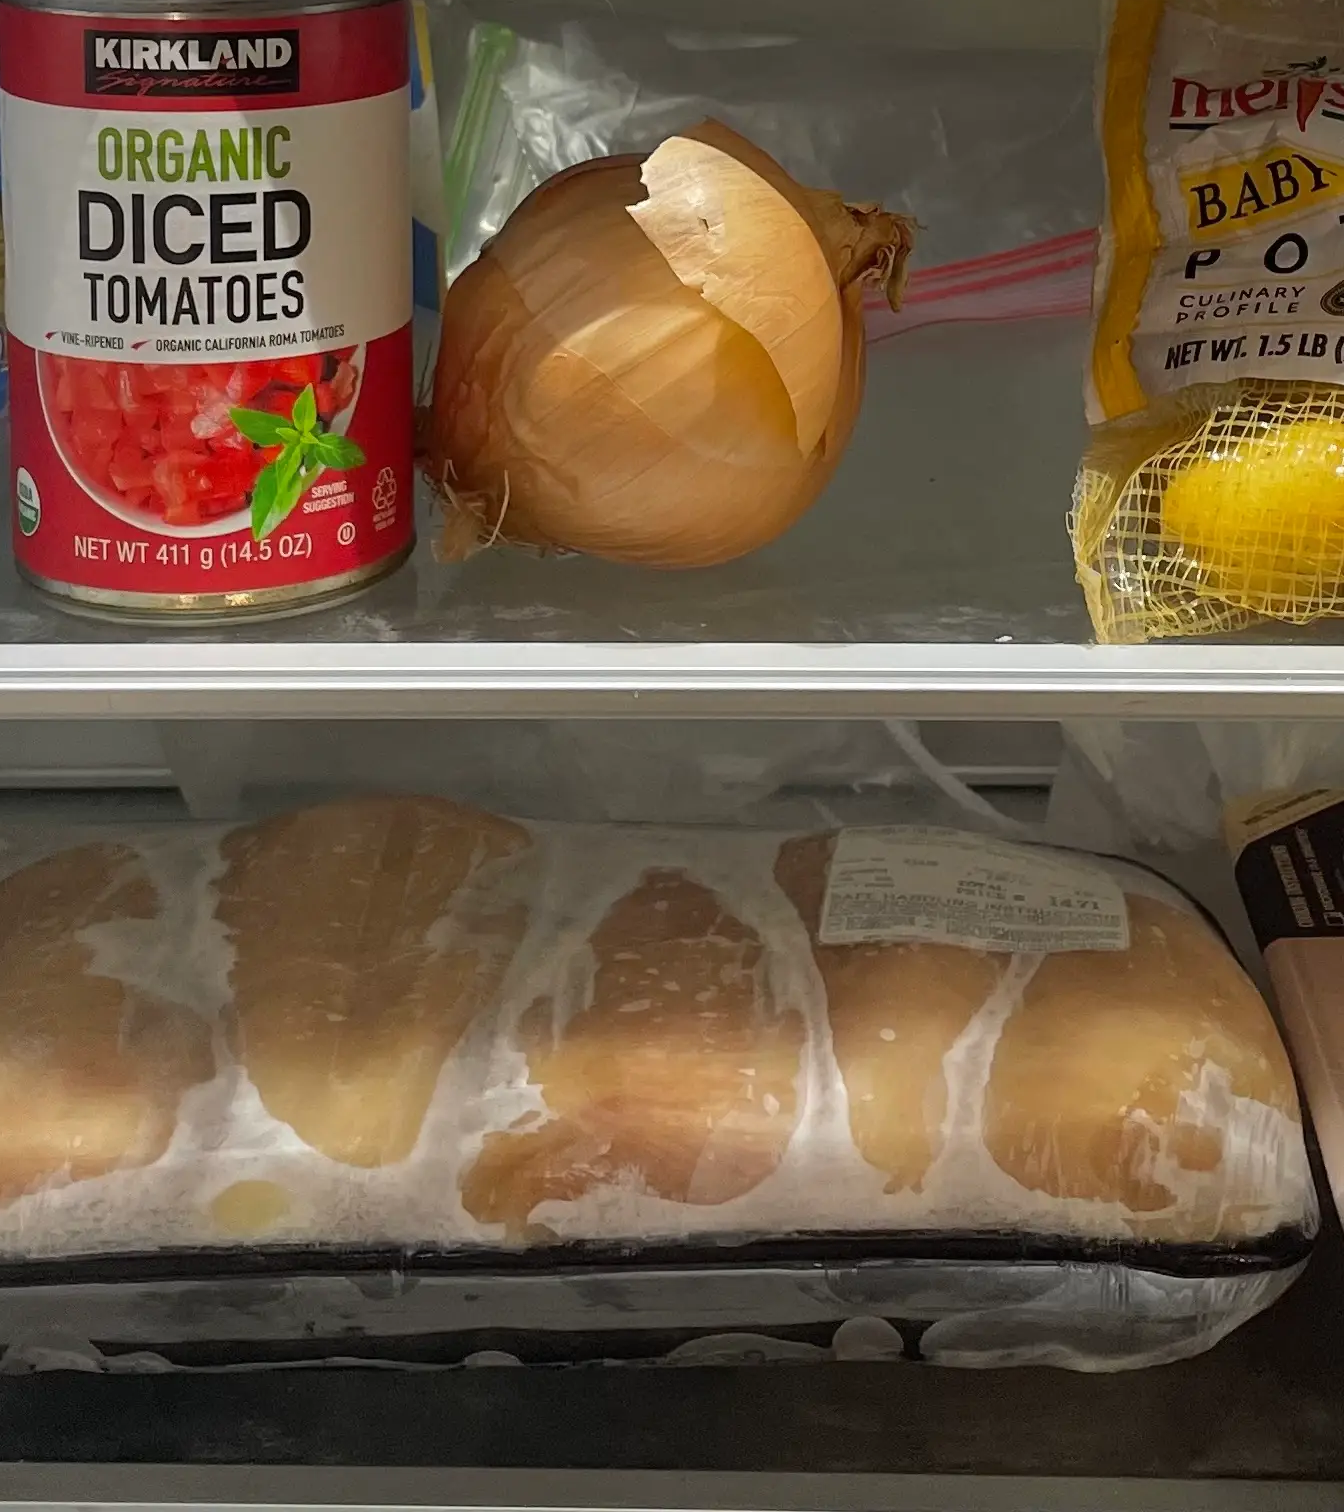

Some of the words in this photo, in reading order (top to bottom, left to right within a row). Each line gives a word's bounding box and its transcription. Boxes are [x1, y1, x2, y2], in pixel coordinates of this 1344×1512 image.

[93, 36, 293, 72] KIRKLAND
[97, 125, 292, 184] ORGANIC
[1189, 153, 1338, 229] BABY
[77, 188, 312, 265] DICED
[83, 269, 305, 326] TOMATOES
[1176, 301, 1301, 324] PROFILE
[1179, 285, 1306, 309] CULINARY
[60, 330, 124, 350] VINE-RIPENED
[156, 339, 202, 353] ORGANIC
[205, 335, 267, 352] CALIFORNIA
[268, 333, 298, 348] ROMA
[299, 324, 345, 343] TOMATOES
[1164, 339, 1208, 370] NET
[1210, 335, 1248, 362] WT.
[1258, 333, 1292, 357] 1.5
[1297, 332, 1329, 357] LB
[73, 534, 113, 561] NET
[116, 536, 151, 566] WT
[155, 539, 191, 566] 411
[199, 546, 214, 570] g
[220, 537, 275, 567] (14.5
[278, 532, 313, 560] OZ)
